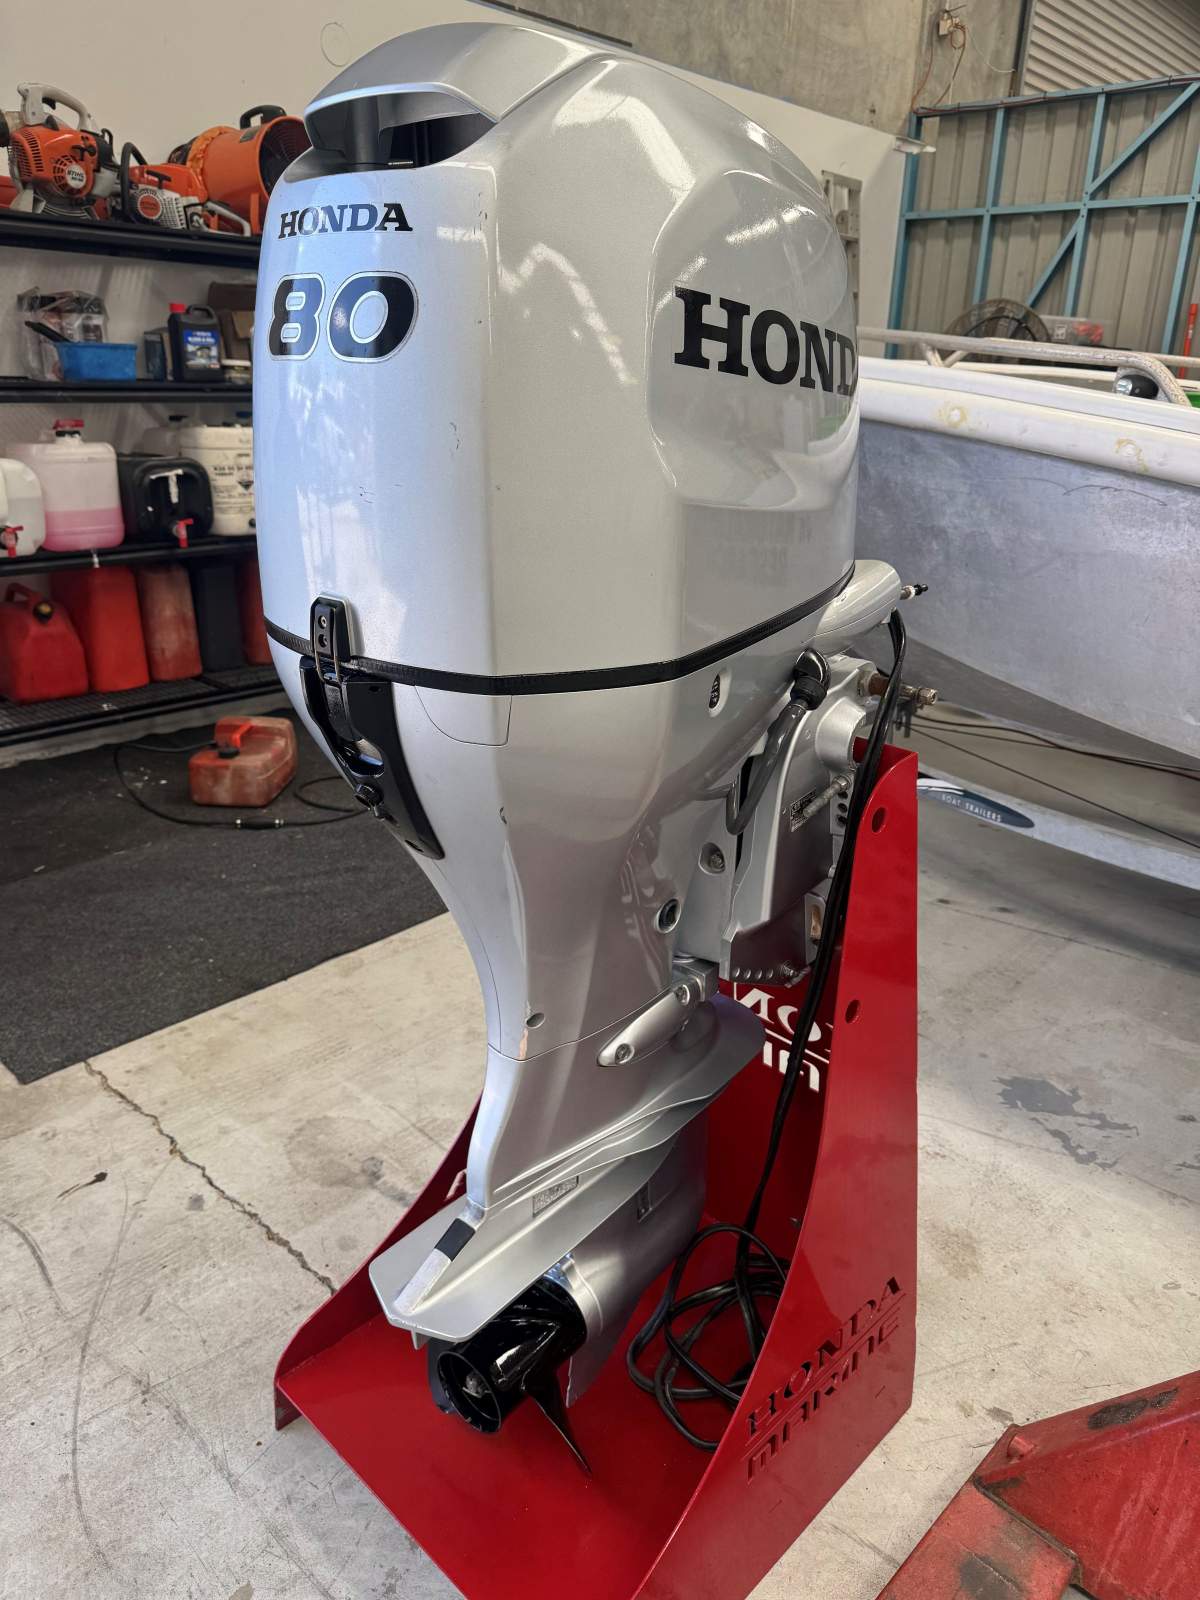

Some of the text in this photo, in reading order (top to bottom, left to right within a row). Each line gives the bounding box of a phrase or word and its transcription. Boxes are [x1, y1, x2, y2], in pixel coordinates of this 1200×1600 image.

[278, 203, 413, 239] HONDA
[269, 271, 419, 364] 80
[674, 285, 858, 397] HOND
[966, 802, 1001, 822] TRAILERS
[746, 1276, 903, 1446] HONDA
